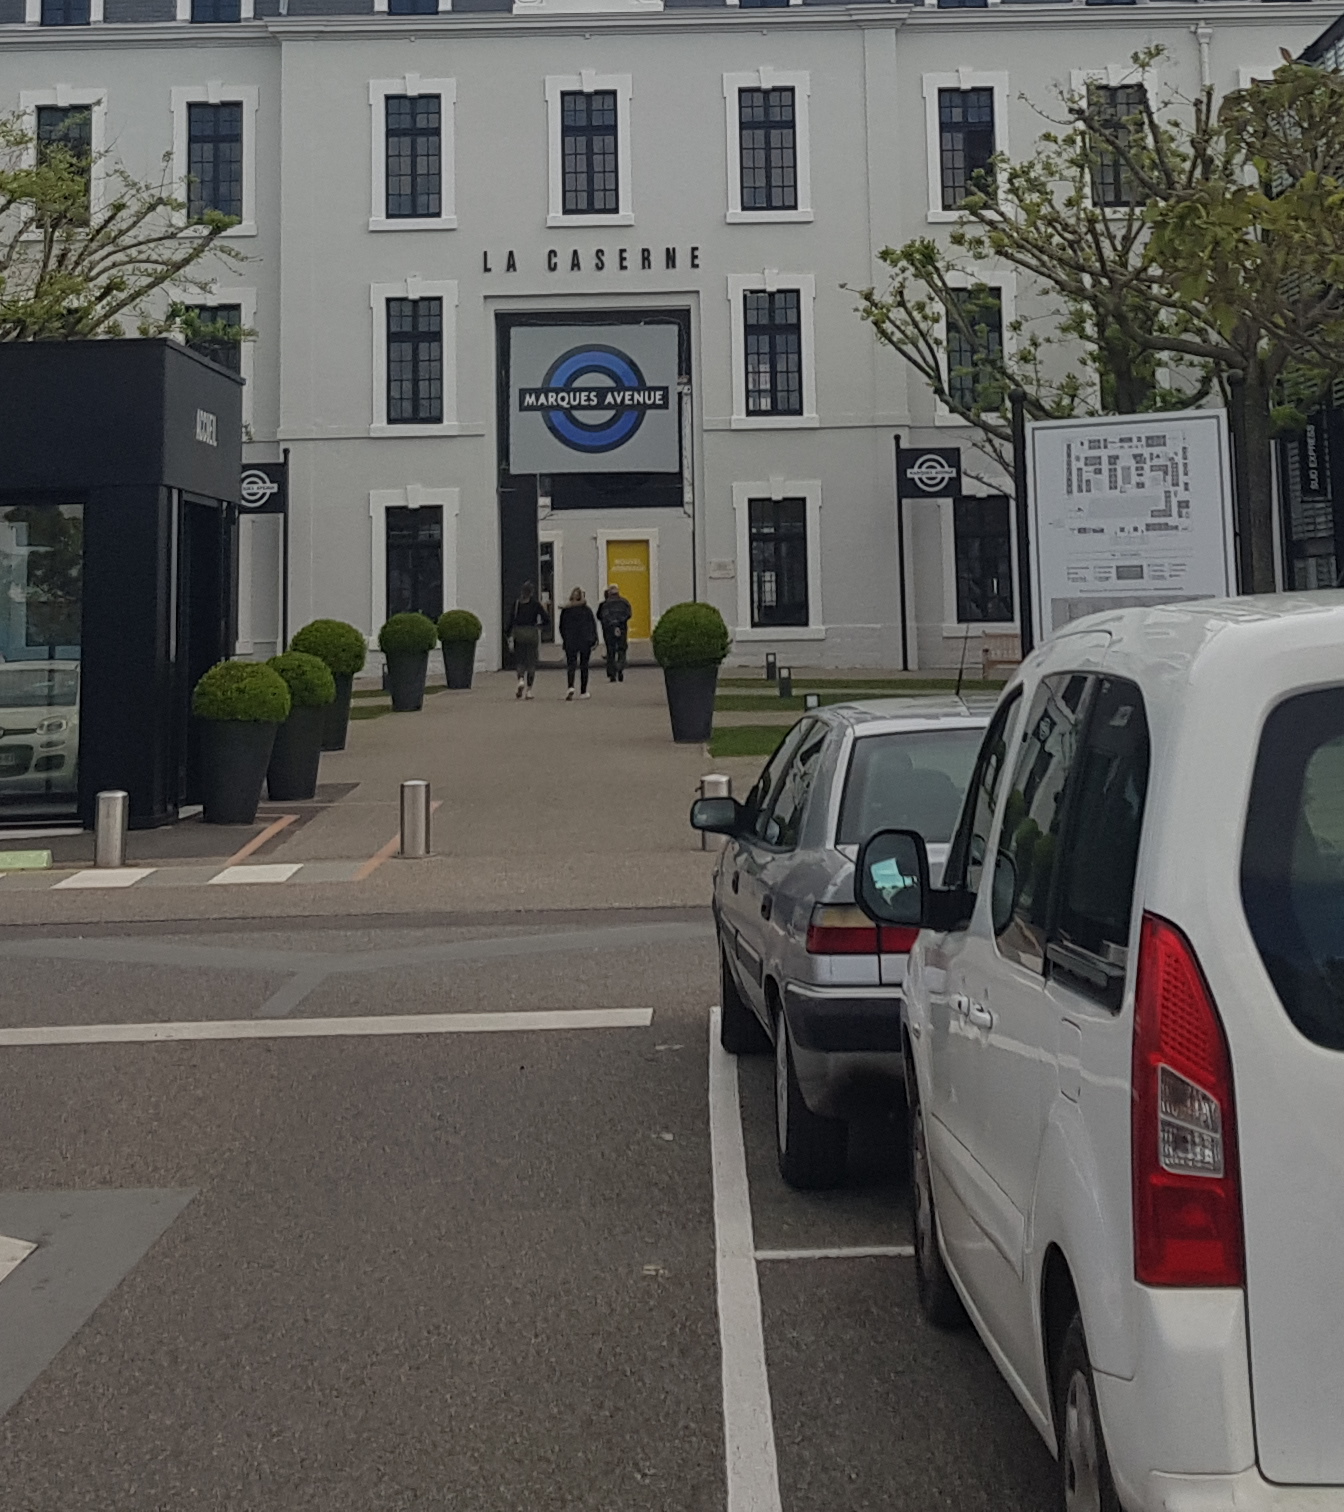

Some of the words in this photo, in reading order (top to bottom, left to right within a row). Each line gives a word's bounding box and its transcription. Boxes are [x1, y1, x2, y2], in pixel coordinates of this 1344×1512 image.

[483, 249, 517, 272] LA
[547, 247, 700, 272] CASERNE
[524, 392, 598, 408] MARQUES
[604, 390, 664, 405] AVENUE
[196, 408, 217, 447] ACCUEIL
